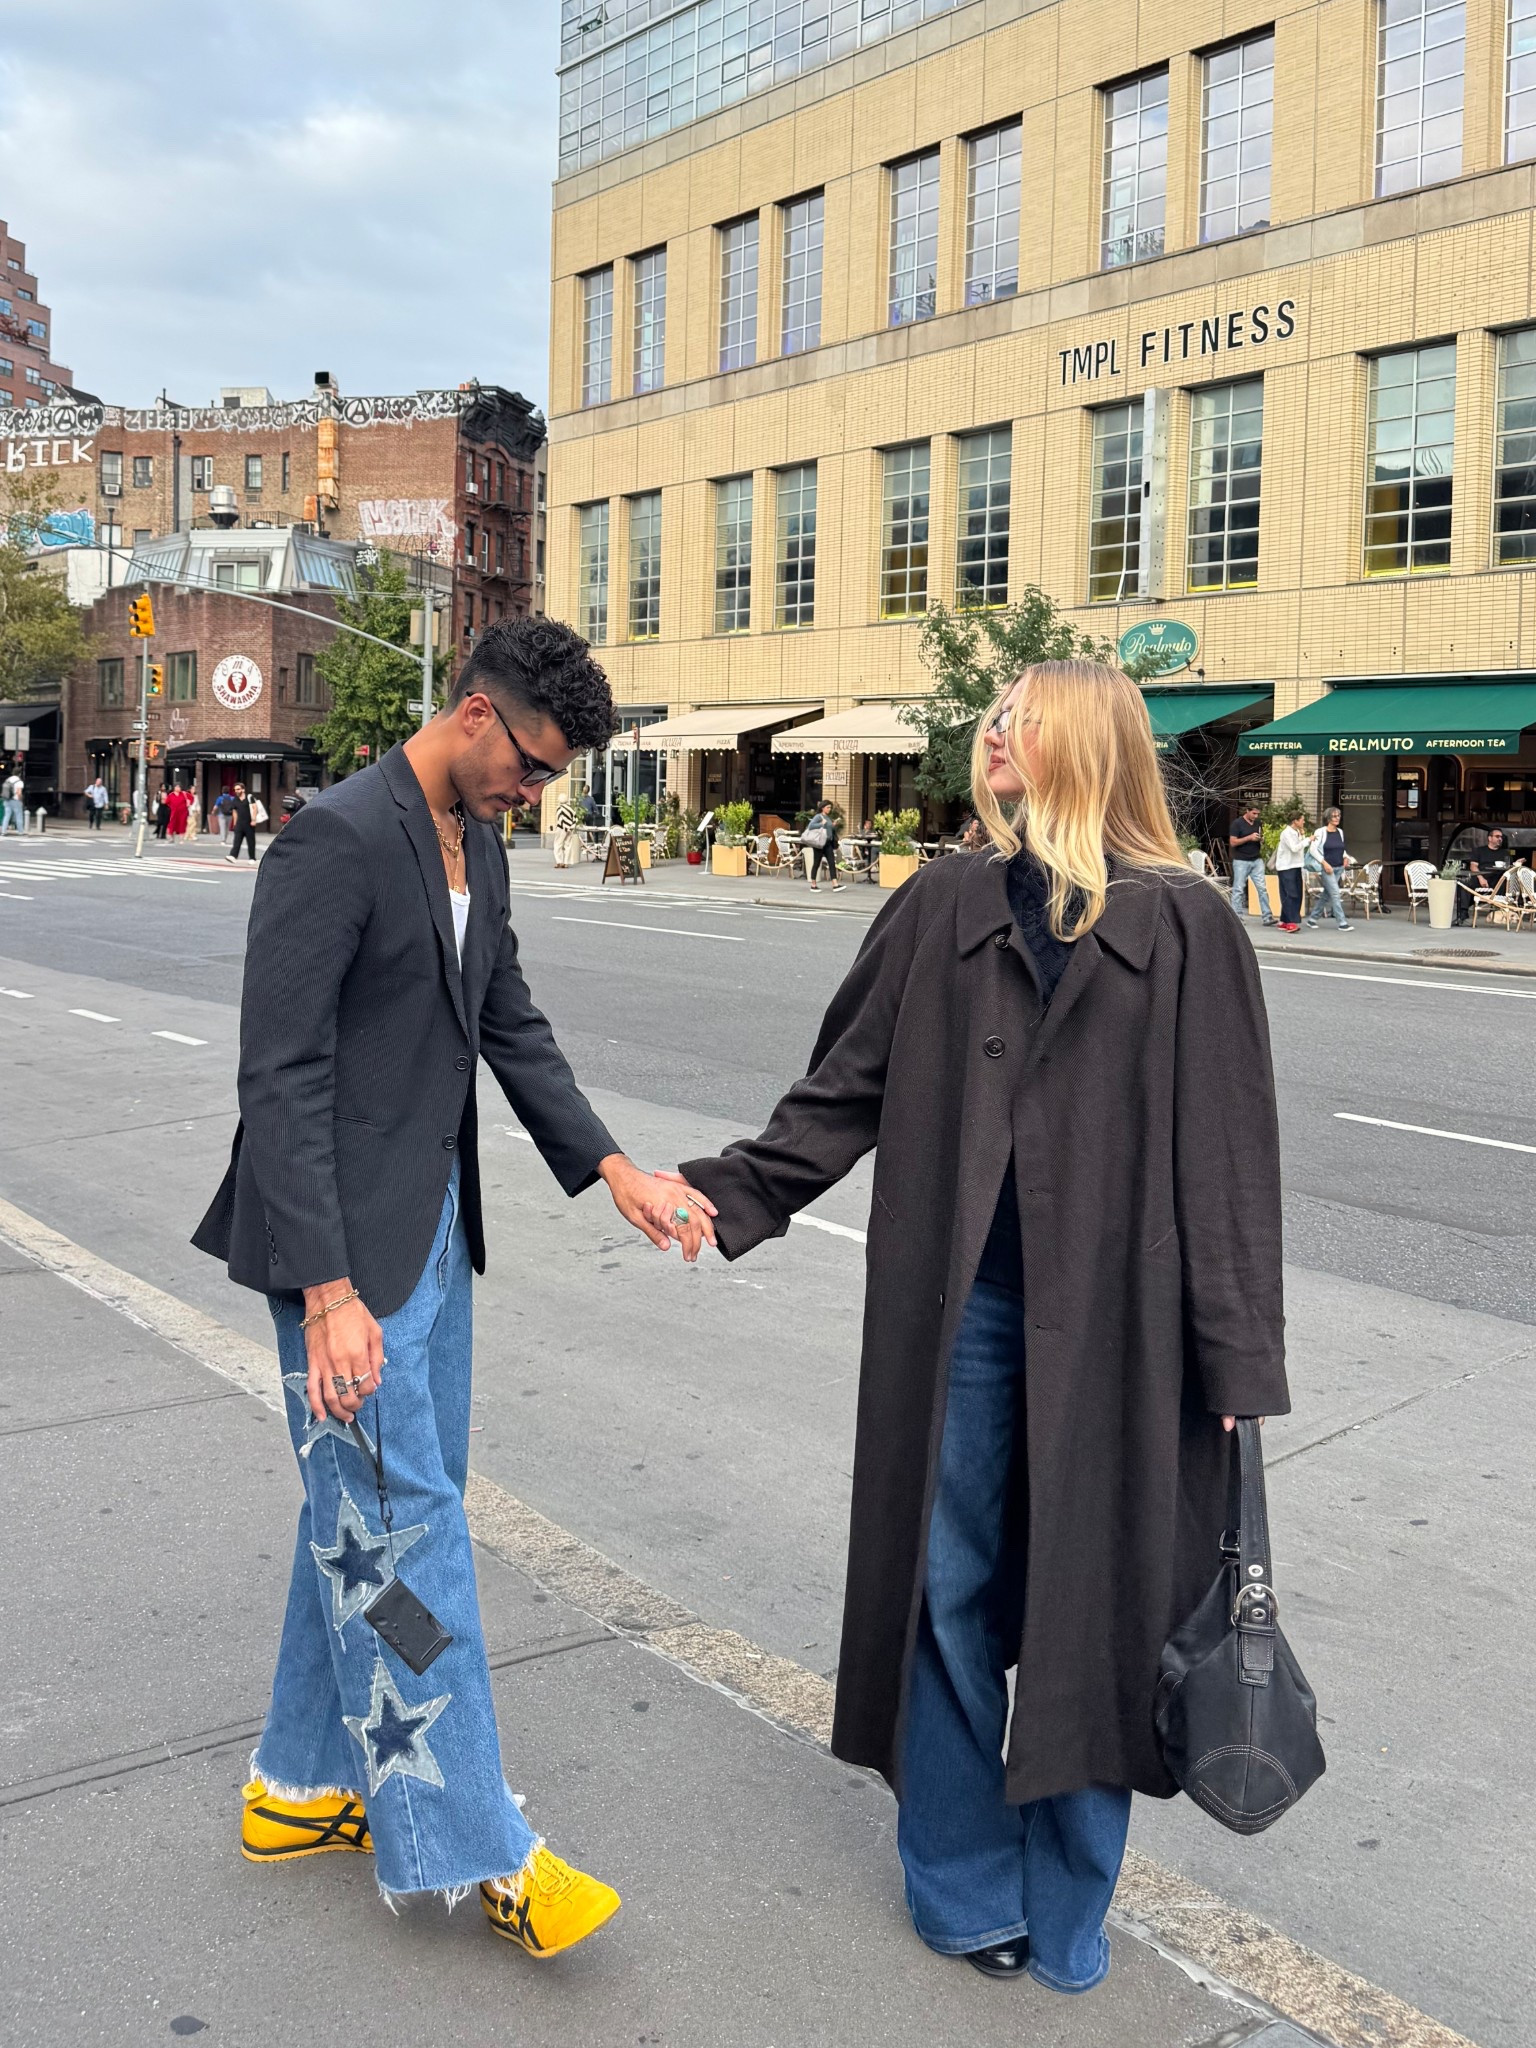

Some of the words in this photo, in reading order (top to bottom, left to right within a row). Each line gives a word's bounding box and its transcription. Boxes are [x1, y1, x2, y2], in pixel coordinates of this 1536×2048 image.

[1058, 339, 1121, 386] TMPL
[1141, 299, 1296, 368] FITNESS
[1125, 632, 1192, 655] Realmuto
[216, 684, 258, 704] SHAWARMA
[833, 739, 859, 751] FICUZZA
[1248, 742, 1303, 750] CAFFETTERIA
[1329, 738, 1414, 751] REALMUTO
[1426, 739, 1485, 748] AFTERNOON
[1487, 738, 1506, 747] TEA
